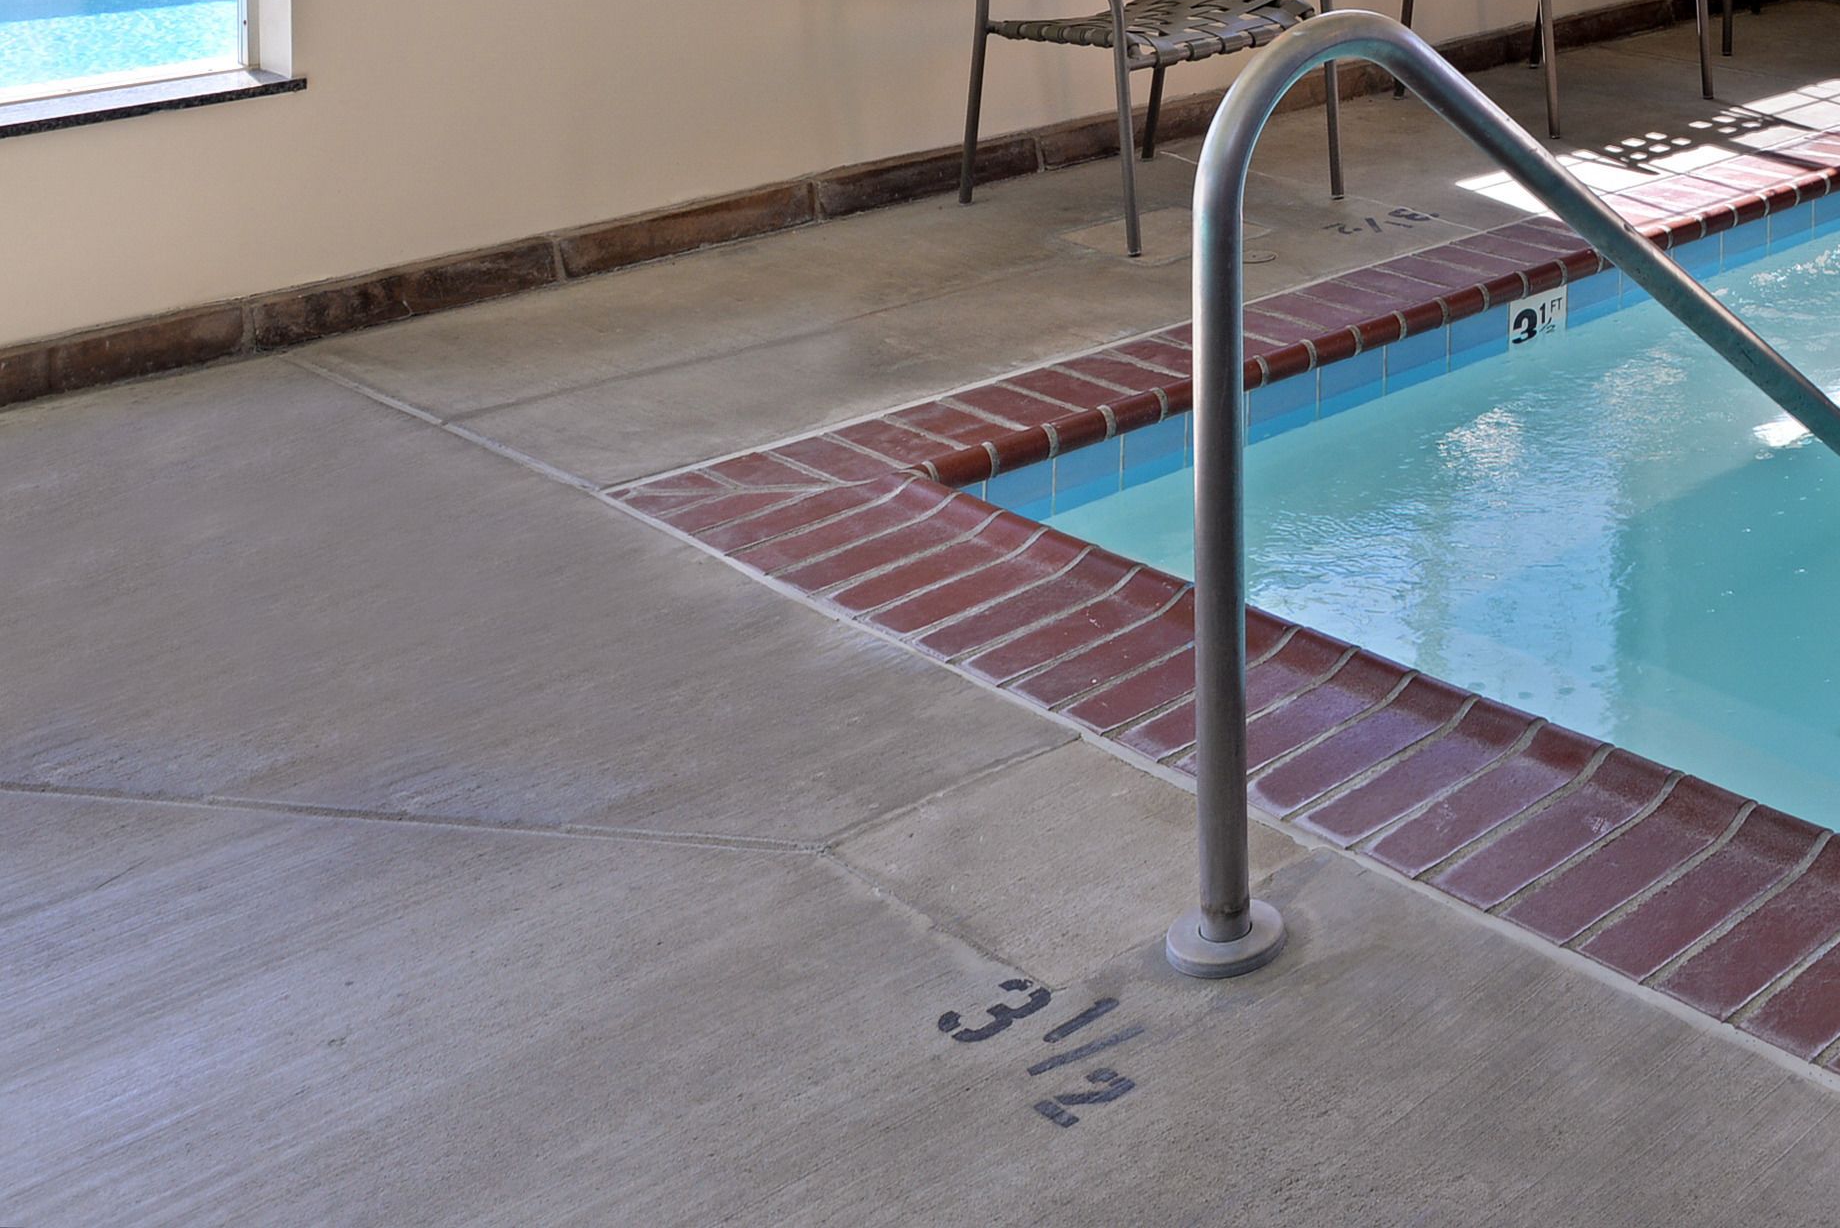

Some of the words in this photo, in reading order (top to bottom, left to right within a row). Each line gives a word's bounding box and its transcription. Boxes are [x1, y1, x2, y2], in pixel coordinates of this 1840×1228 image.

[1512, 308, 1538, 344] 3
[1550, 297, 1562, 313] FT
[937, 978, 1051, 1043] 3
